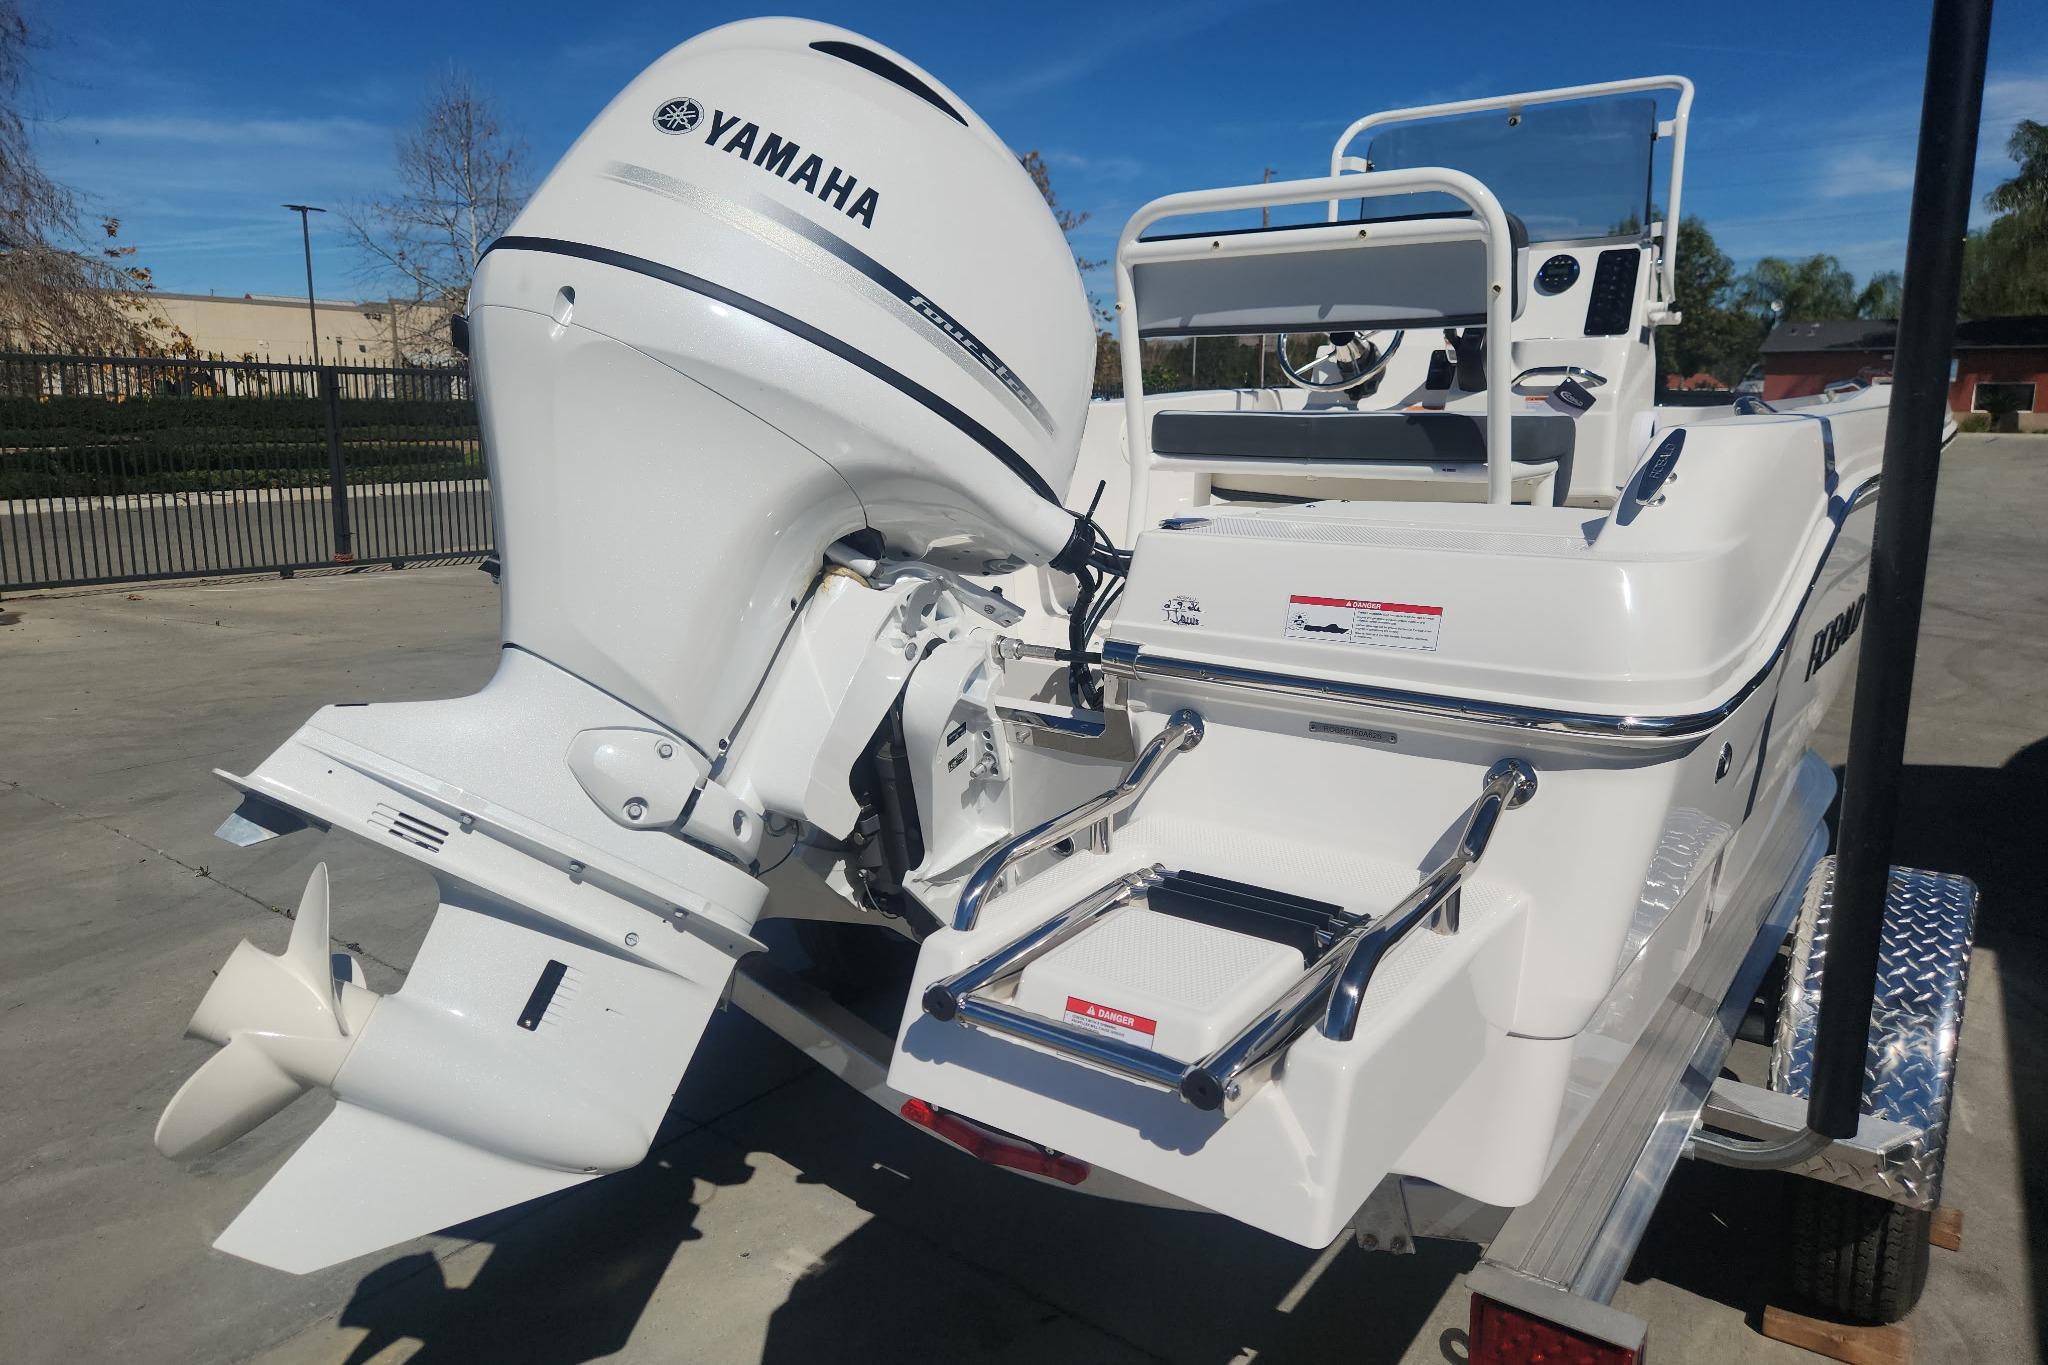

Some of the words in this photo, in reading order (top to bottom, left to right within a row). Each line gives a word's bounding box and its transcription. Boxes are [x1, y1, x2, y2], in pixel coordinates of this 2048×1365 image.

[704, 109, 880, 229] YAMAHA
[908, 295, 1044, 414] fourstro
[1352, 601, 1382, 610] DANGER
[1098, 1008, 1135, 1027] DANGER
